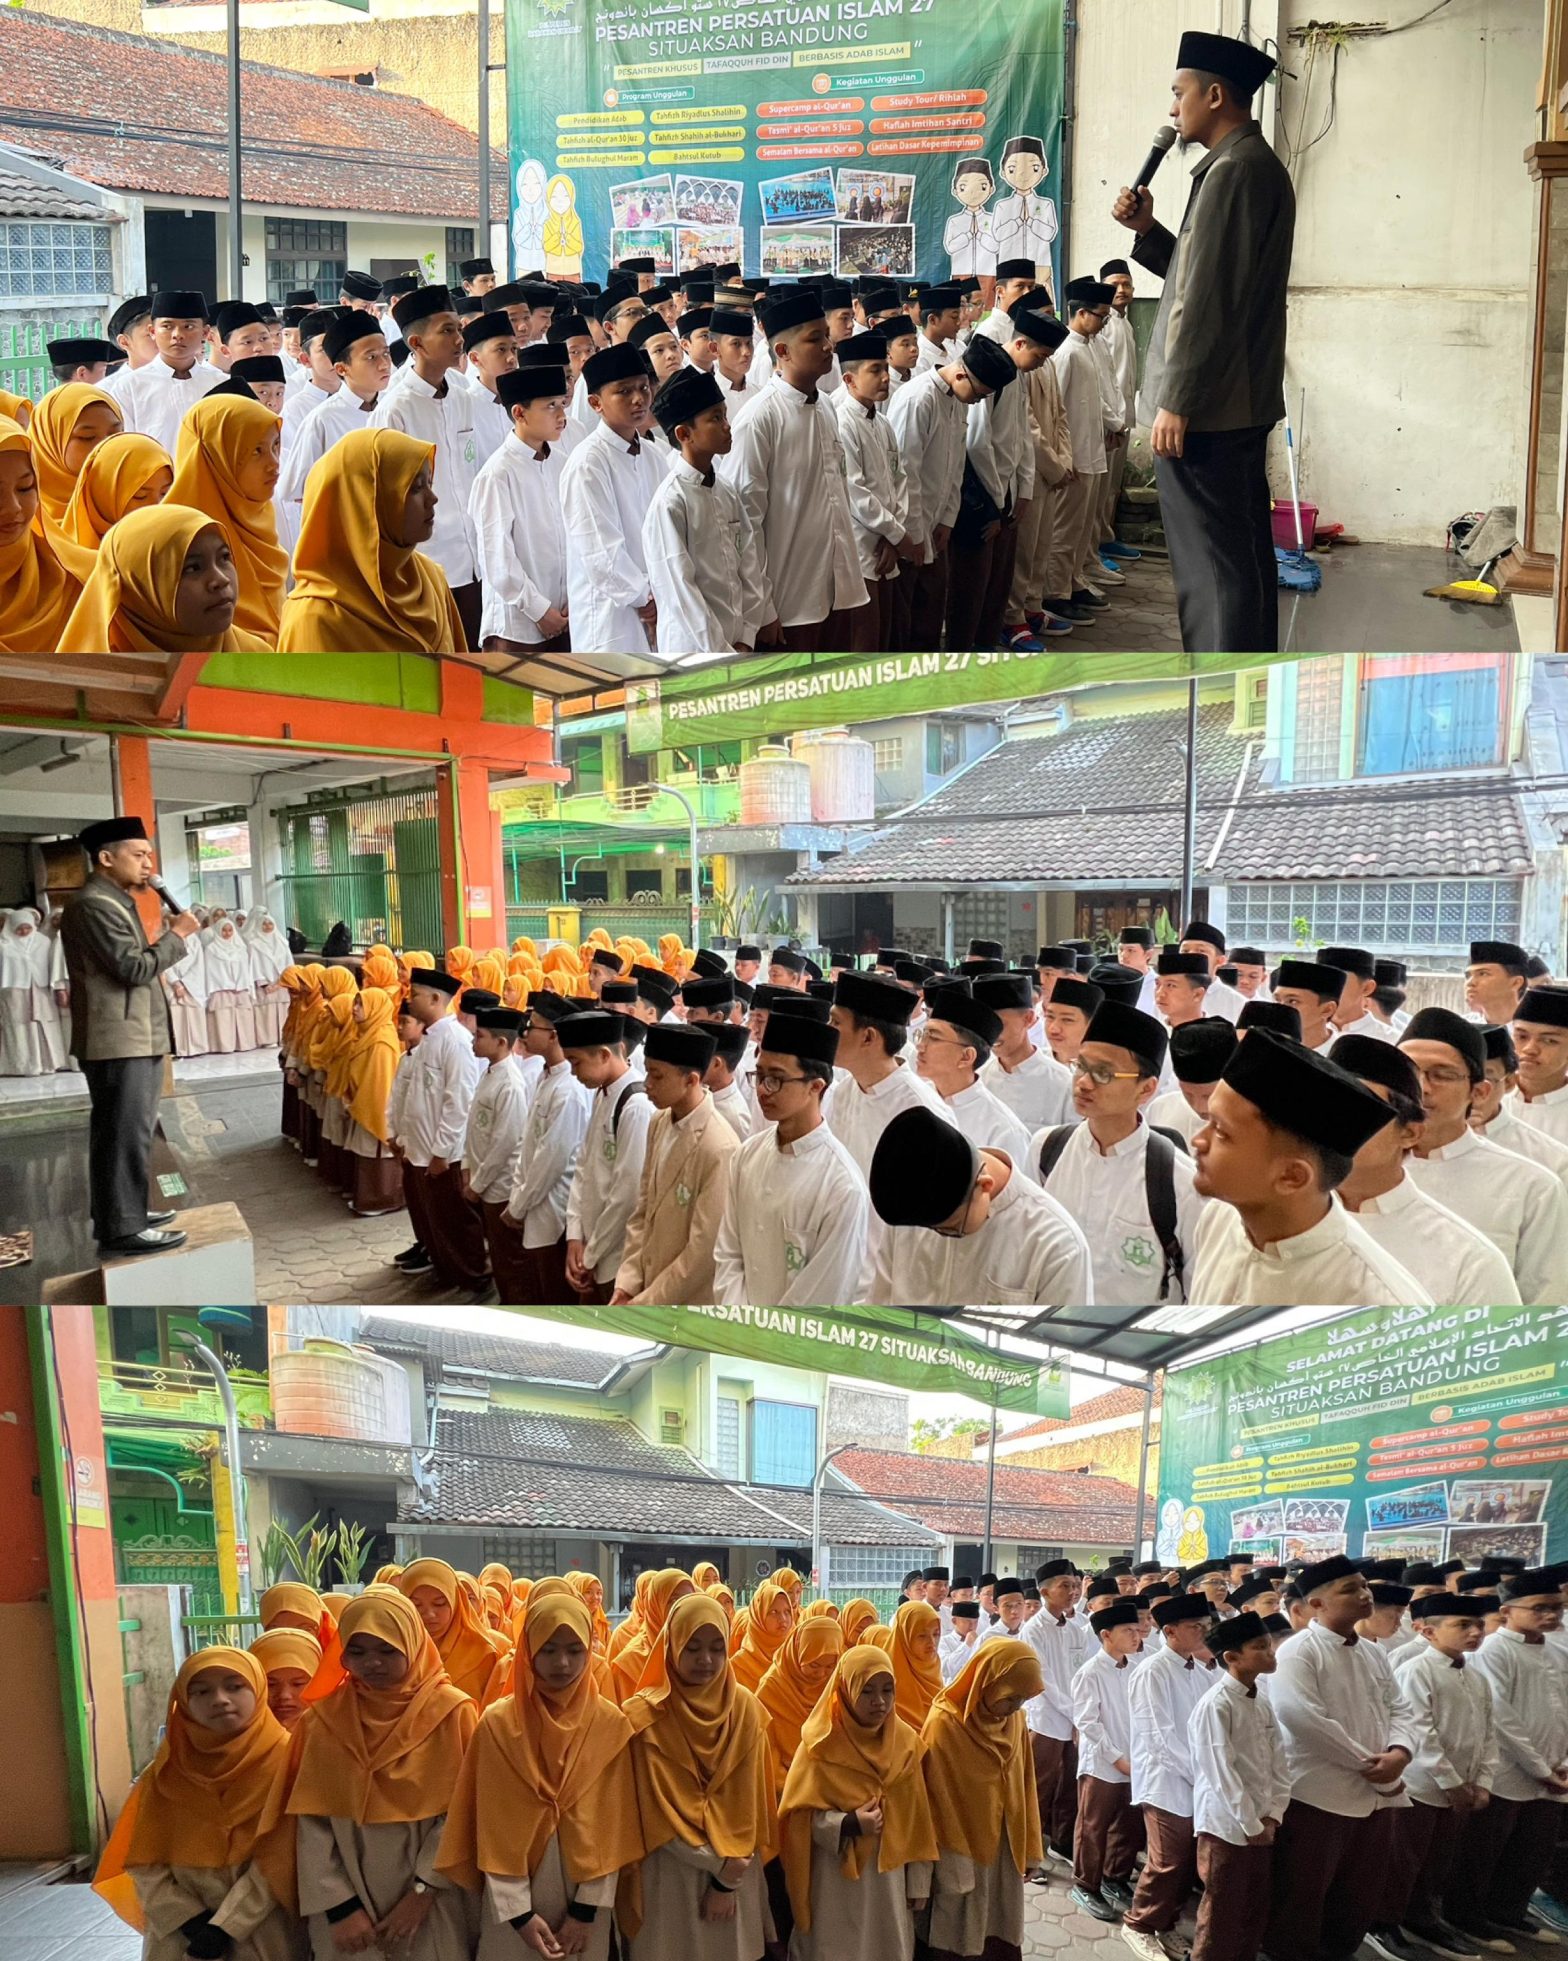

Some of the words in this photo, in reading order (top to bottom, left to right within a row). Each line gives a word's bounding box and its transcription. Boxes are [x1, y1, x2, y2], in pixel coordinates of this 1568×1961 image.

[595, 17, 702, 42] PESANTREN
[709, 4, 829, 31] PERSATUAN
[838, 0, 903, 20] ISLAM
[648, 33, 753, 56] SITUAKSAN
[761, 23, 868, 47] BANDUNG
[706, 58, 753, 69] TAFAQQUH
[755, 57, 771, 66] FID
[772, 55, 788, 64] DIN
[799, 51, 844, 62] BERBASIS
[846, 49, 873, 59] ADAB
[875, 47, 904, 57] ISLAM
[617, 66, 664, 76] PESANTREN
[665, 63, 698, 73] KHUSUS
[836, 78, 873, 87] Kegiatan
[874, 74, 916, 84] Unggulan
[622, 93, 651, 102] Program
[652, 90, 687, 99] Unggulan
[889, 97, 913, 106] Study
[768, 103, 811, 114] Supercamp
[813, 100, 851, 111] al-Qur'an
[911, 119, 944, 128] Imtihan
[946, 116, 972, 126] Santri
[899, 140, 920, 149] Dasar
[669, 688, 761, 720] PESANTREN
[764, 665, 873, 704] PERSATUAN
[876, 652, 940, 684] ISLAM
[944, 652, 971, 671] 27
[671, 1305, 796, 1335] RSATUAN
[800, 1317, 856, 1347] ISLAM
[858, 1330, 879, 1352] 27
[1286, 1340, 1368, 1373] SELAMAT
[1371, 1315, 1458, 1349] DATANG
[1464, 1306, 1490, 1323] DI
[1228, 1383, 1323, 1416] PESANTREN
[1328, 1349, 1457, 1392] PERSATUAN
[1464, 1326, 1549, 1360] ISLAM
[1271, 1386, 1372, 1419] SITUAKSAN
[1379, 1357, 1500, 1396] BANDUNG
[1418, 1384, 1469, 1401] BERBASIS
[1508, 1369, 1546, 1382] ISLAM
[1458, 1400, 1504, 1414] Kegiatan
[1505, 1390, 1560, 1405] Unggulan
